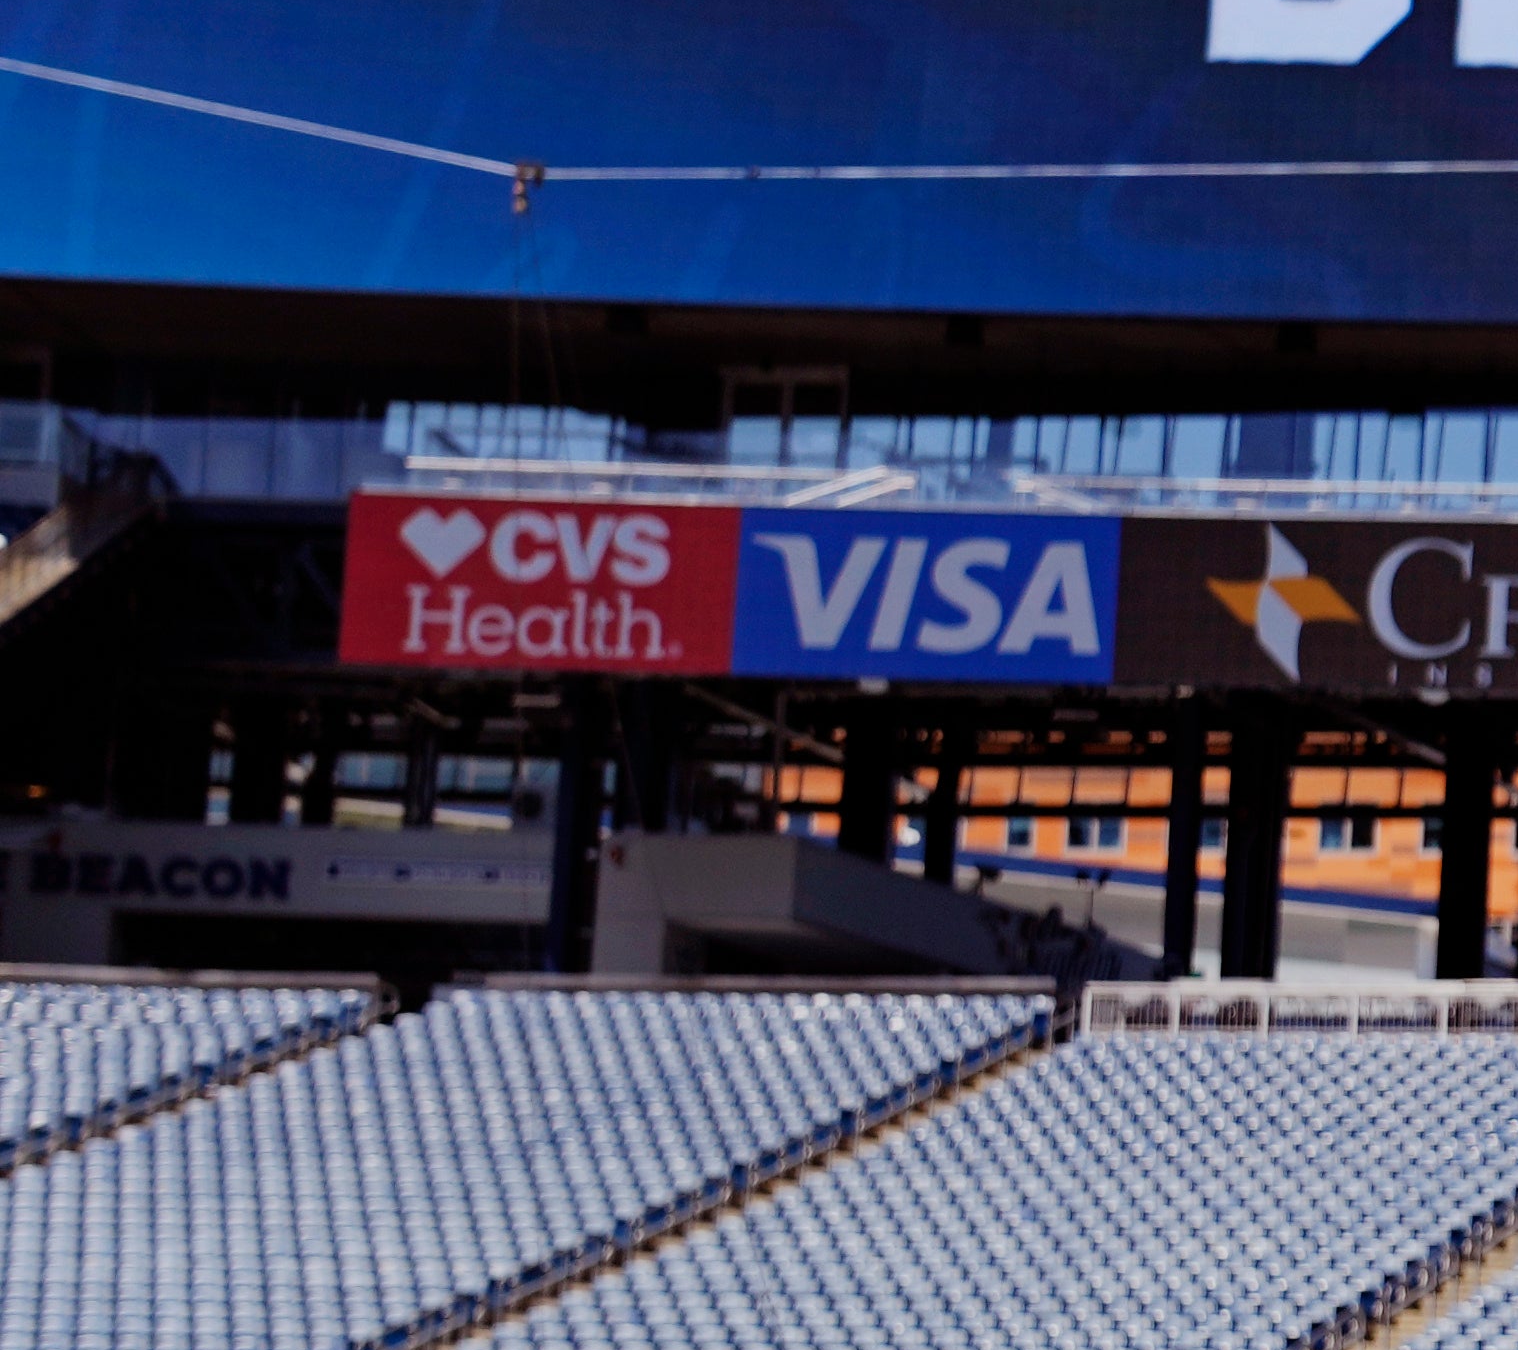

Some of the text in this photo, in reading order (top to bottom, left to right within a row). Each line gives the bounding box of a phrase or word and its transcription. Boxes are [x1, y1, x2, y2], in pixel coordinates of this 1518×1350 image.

[490, 510, 672, 588] CVS
[404, 584, 665, 660] Health
[750, 532, 1101, 657] VISA
[28, 855, 294, 903] BEACON
